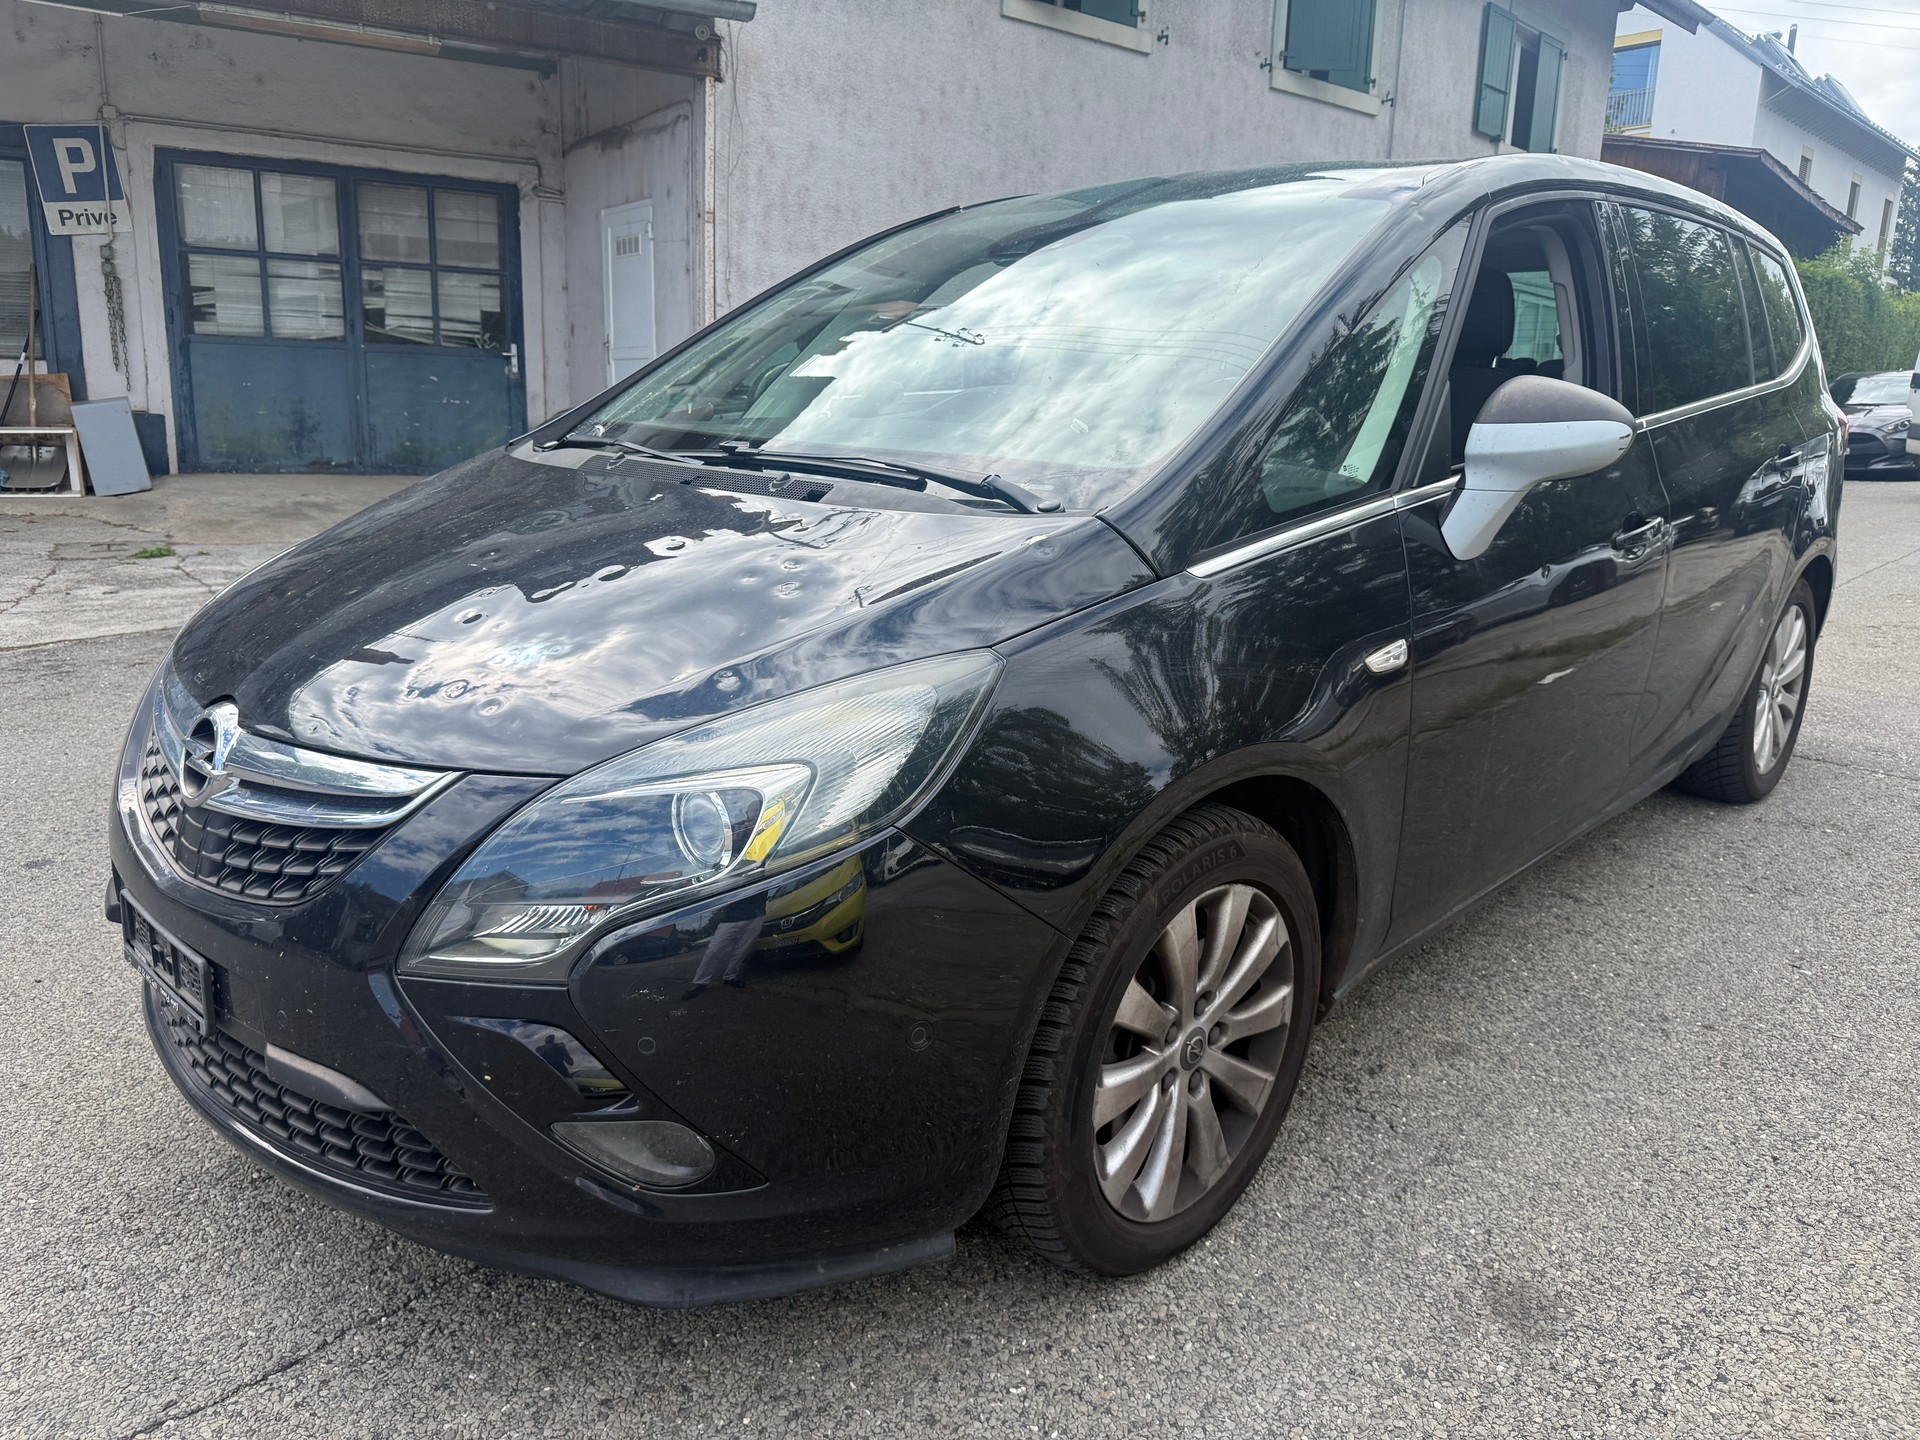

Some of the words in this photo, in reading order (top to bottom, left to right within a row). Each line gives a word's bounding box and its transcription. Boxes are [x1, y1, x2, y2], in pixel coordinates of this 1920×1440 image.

[52, 137, 97, 194] P
[1161, 848, 1226, 905] POLARIS
[1230, 844, 1237, 859] 6
